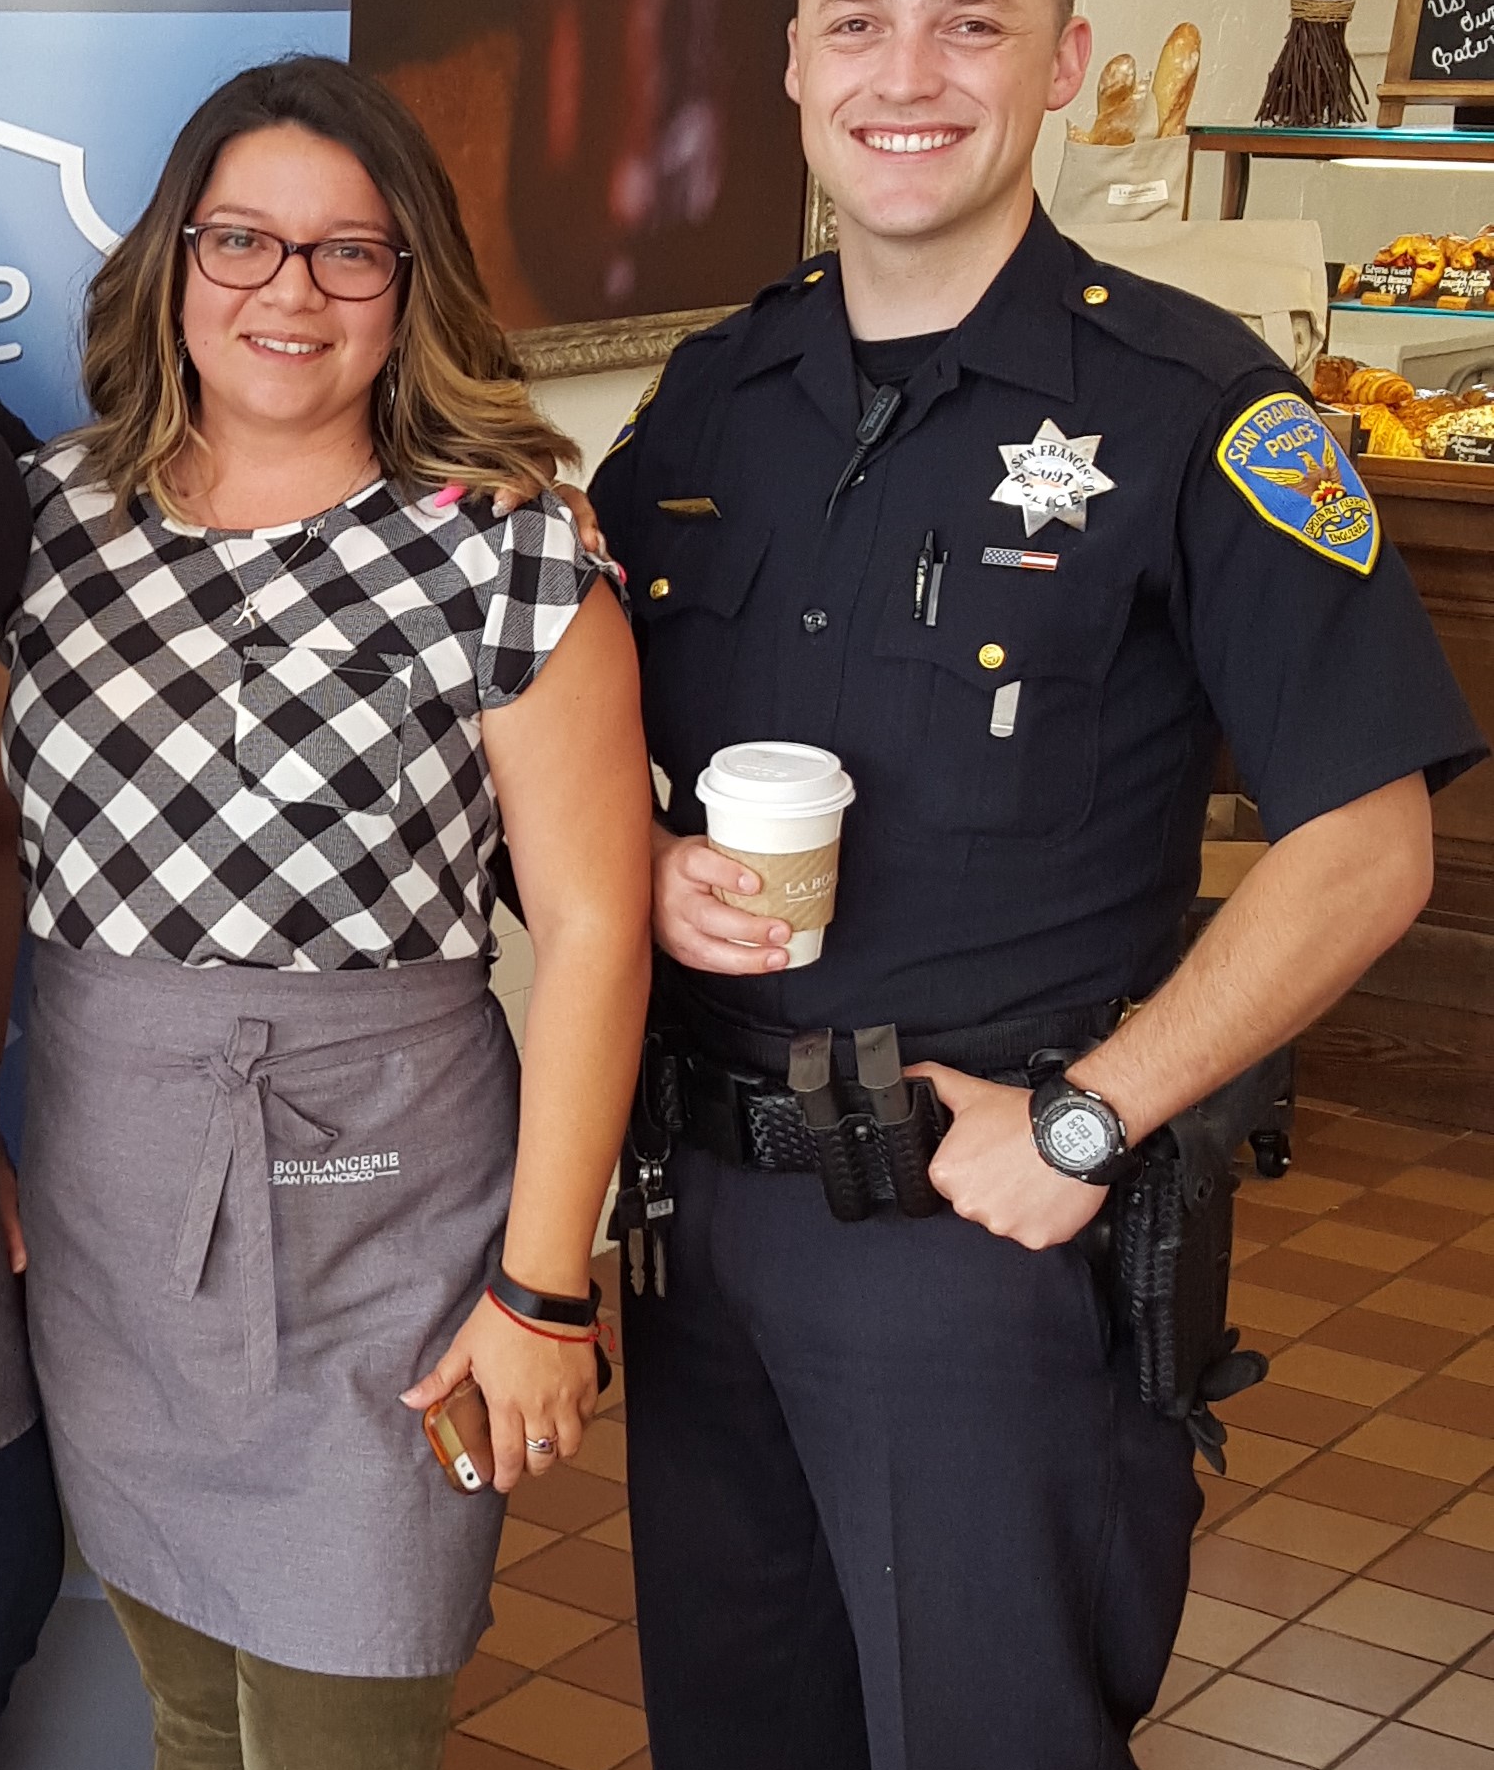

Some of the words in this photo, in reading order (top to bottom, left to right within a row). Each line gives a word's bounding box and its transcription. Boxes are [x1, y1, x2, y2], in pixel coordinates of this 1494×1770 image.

[1432, 34, 1494, 74] Cater
[1227, 426, 1262, 466] SAN
[1264, 423, 1318, 459] POLICE
[1011, 448, 1036, 469] SAN
[1040, 444, 1095, 491] FRANCISCO
[1010, 473, 1082, 507] POLICE
[786, 881, 807, 895] LA
[272, 1173, 301, 1186] SAN
[303, 1169, 376, 1186] FRANCISCO
[273, 1152, 400, 1175] BOULANGERIE
